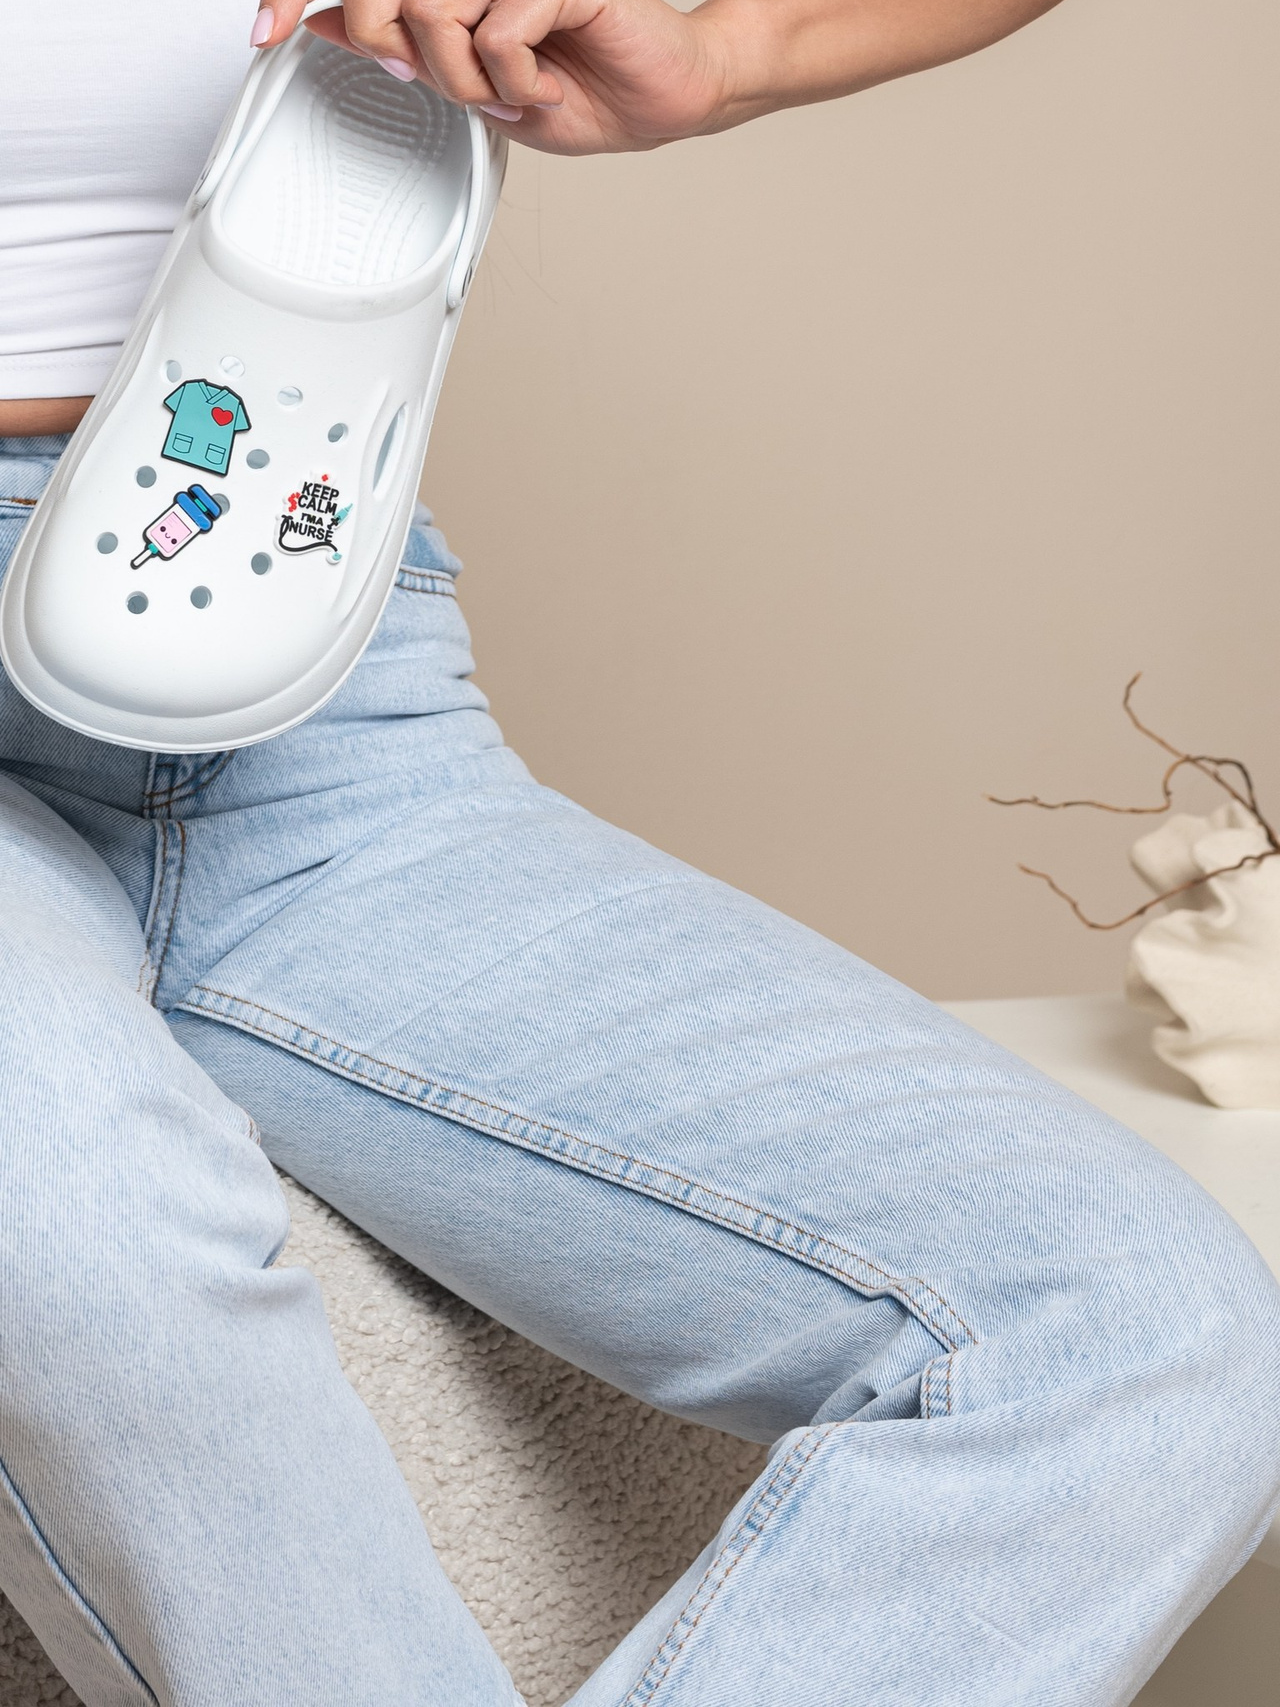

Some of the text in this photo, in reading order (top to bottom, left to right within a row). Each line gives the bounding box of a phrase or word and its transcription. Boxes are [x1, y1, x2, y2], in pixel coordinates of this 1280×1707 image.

[301, 481, 339, 501] KEEP
[298, 494, 337, 515] CALM
[289, 520, 334, 543] NURSE
[316, 517, 323, 526] A
